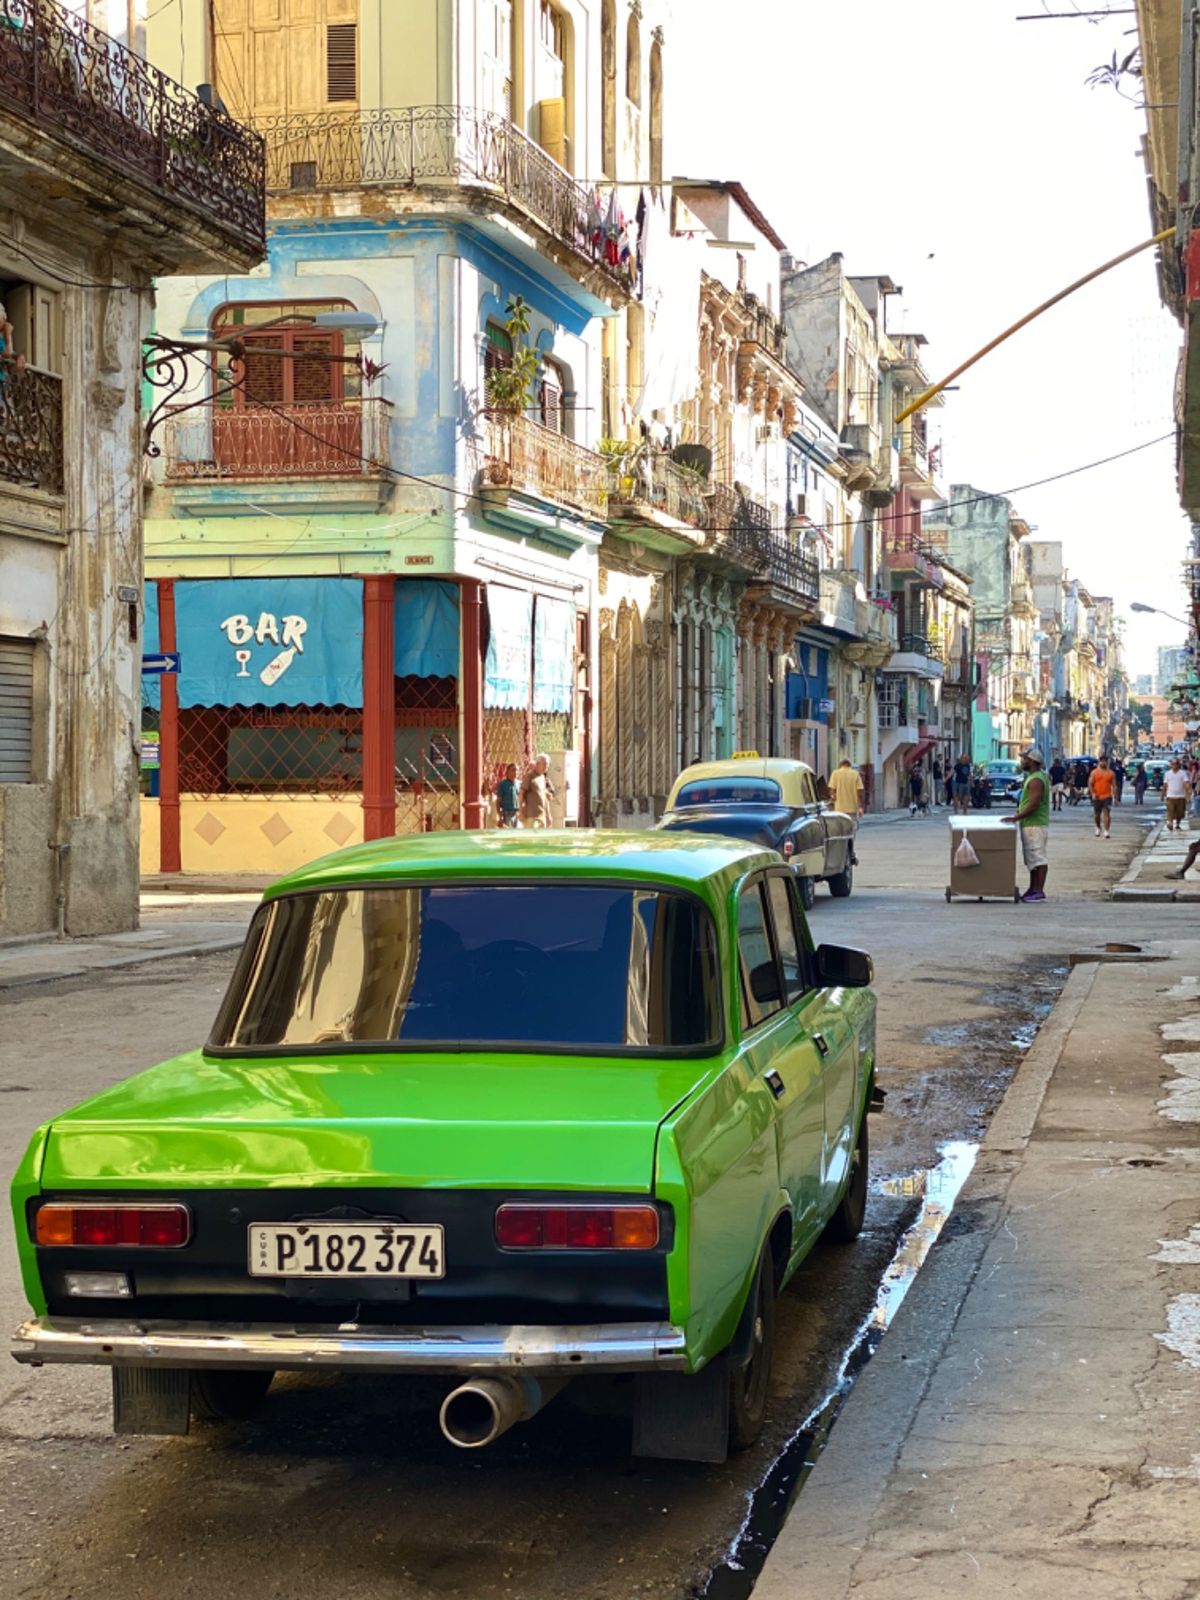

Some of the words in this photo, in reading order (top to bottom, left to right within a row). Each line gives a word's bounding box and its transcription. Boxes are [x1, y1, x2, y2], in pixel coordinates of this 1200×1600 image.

[220, 611, 308, 655] BAR
[259, 1231, 268, 1268] CUBA
[374, 1234, 439, 1273] 374
